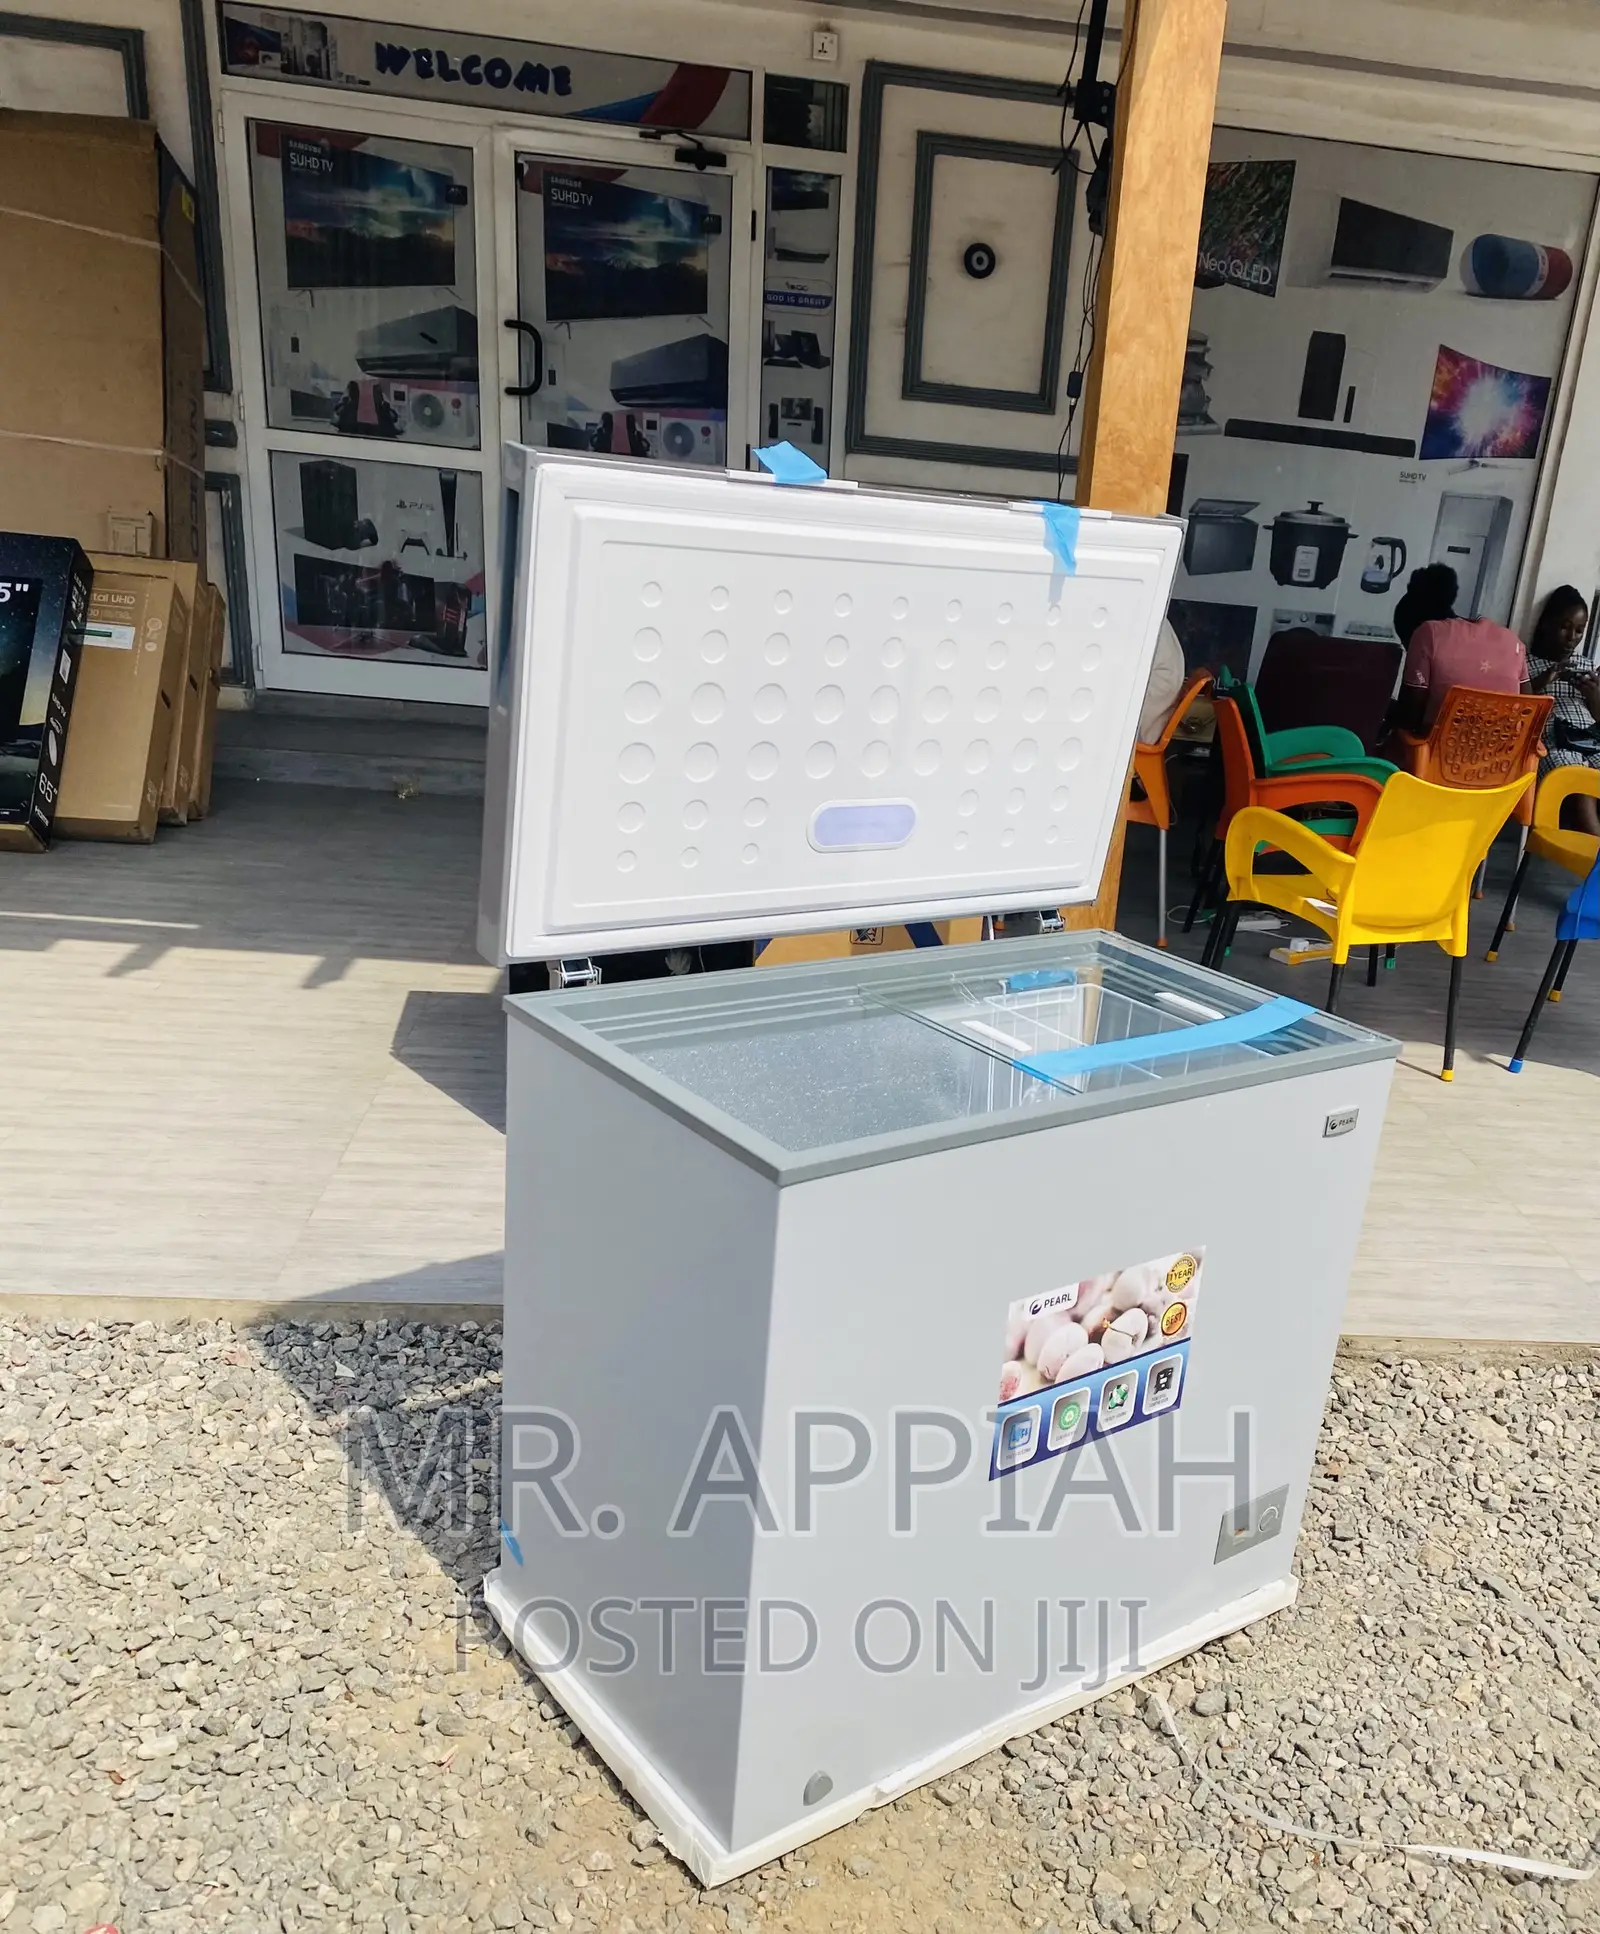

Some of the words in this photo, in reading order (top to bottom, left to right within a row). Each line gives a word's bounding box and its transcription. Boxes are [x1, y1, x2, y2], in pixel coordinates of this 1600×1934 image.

[375, 41, 572, 96] WELCOME
[1198, 251, 1228, 275] Neo
[1229, 259, 1272, 285] QLED
[766, 293, 785, 302] GOD
[787, 295, 796, 303] IS
[111, 594, 136, 605] UHD
[38, 772, 58, 803] 65"
[1043, 1293, 1073, 1309] PEARL
